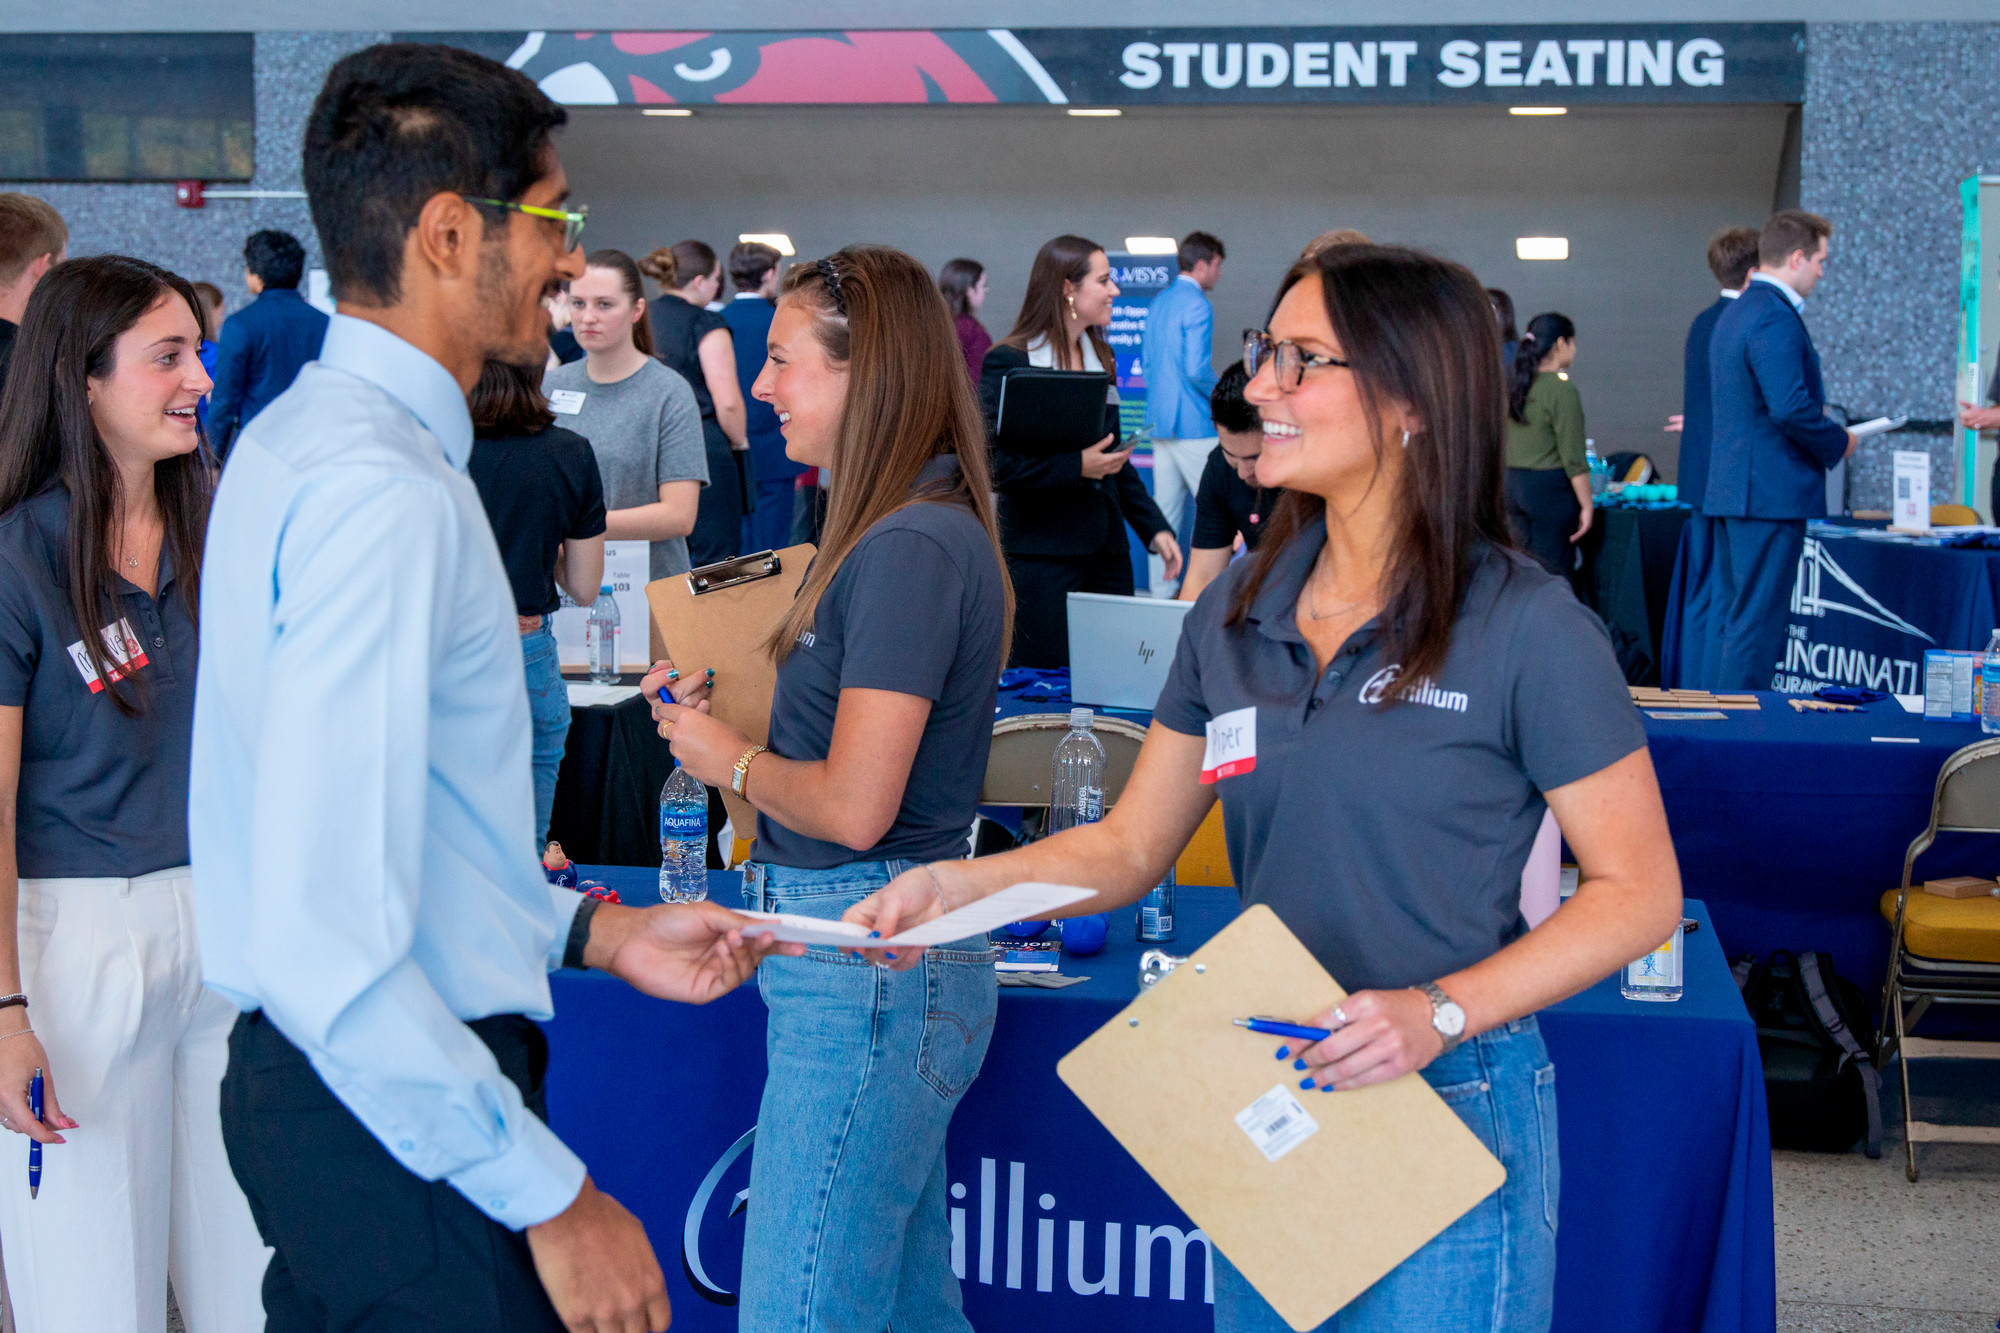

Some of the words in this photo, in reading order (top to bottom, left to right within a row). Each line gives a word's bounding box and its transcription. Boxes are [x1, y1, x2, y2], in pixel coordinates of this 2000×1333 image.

[1119, 40, 1418, 89] STUDENT
[1437, 37, 1725, 88] SEATING
[613, 583, 630, 591] 103
[1788, 623, 1809, 641] THE
[1138, 640, 1154, 665] hp
[1775, 638, 1918, 695] INCINNATI
[663, 817, 701, 829] AQUAFINA
